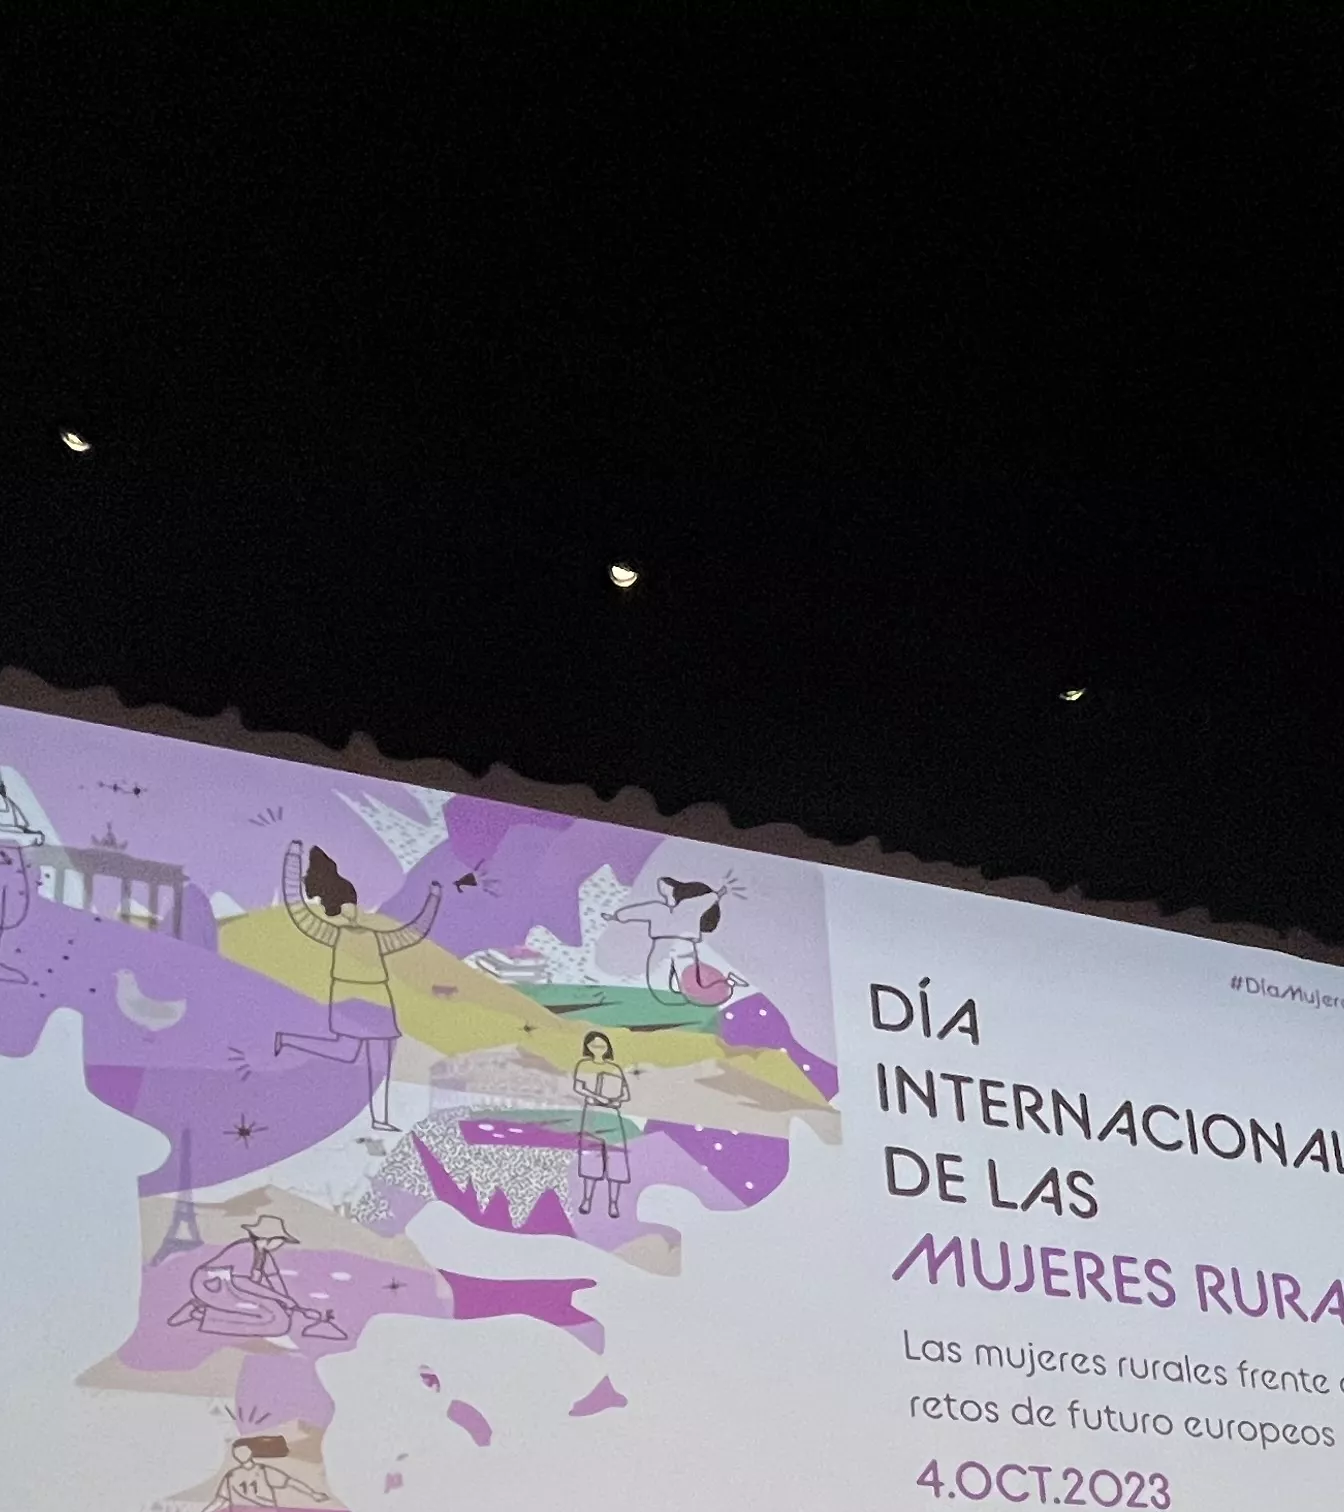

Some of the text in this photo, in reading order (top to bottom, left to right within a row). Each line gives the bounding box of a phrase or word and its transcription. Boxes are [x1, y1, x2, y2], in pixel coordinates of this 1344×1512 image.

[870, 976, 980, 1045] DÍA
[884, 1145, 1099, 1220] DE LAS
[892, 1233, 1176, 1309] MUJERES
[903, 1329, 962, 1364] Las
[975, 1343, 1107, 1378] mujeres
[1117, 1353, 1228, 1387] rurales
[1238, 1360, 1331, 1396] frente
[909, 1394, 1336, 1450] retos de futuro europeos
[239, 1480, 258, 1495] 11
[916, 1459, 1172, 1510] 4.OCT.2023
